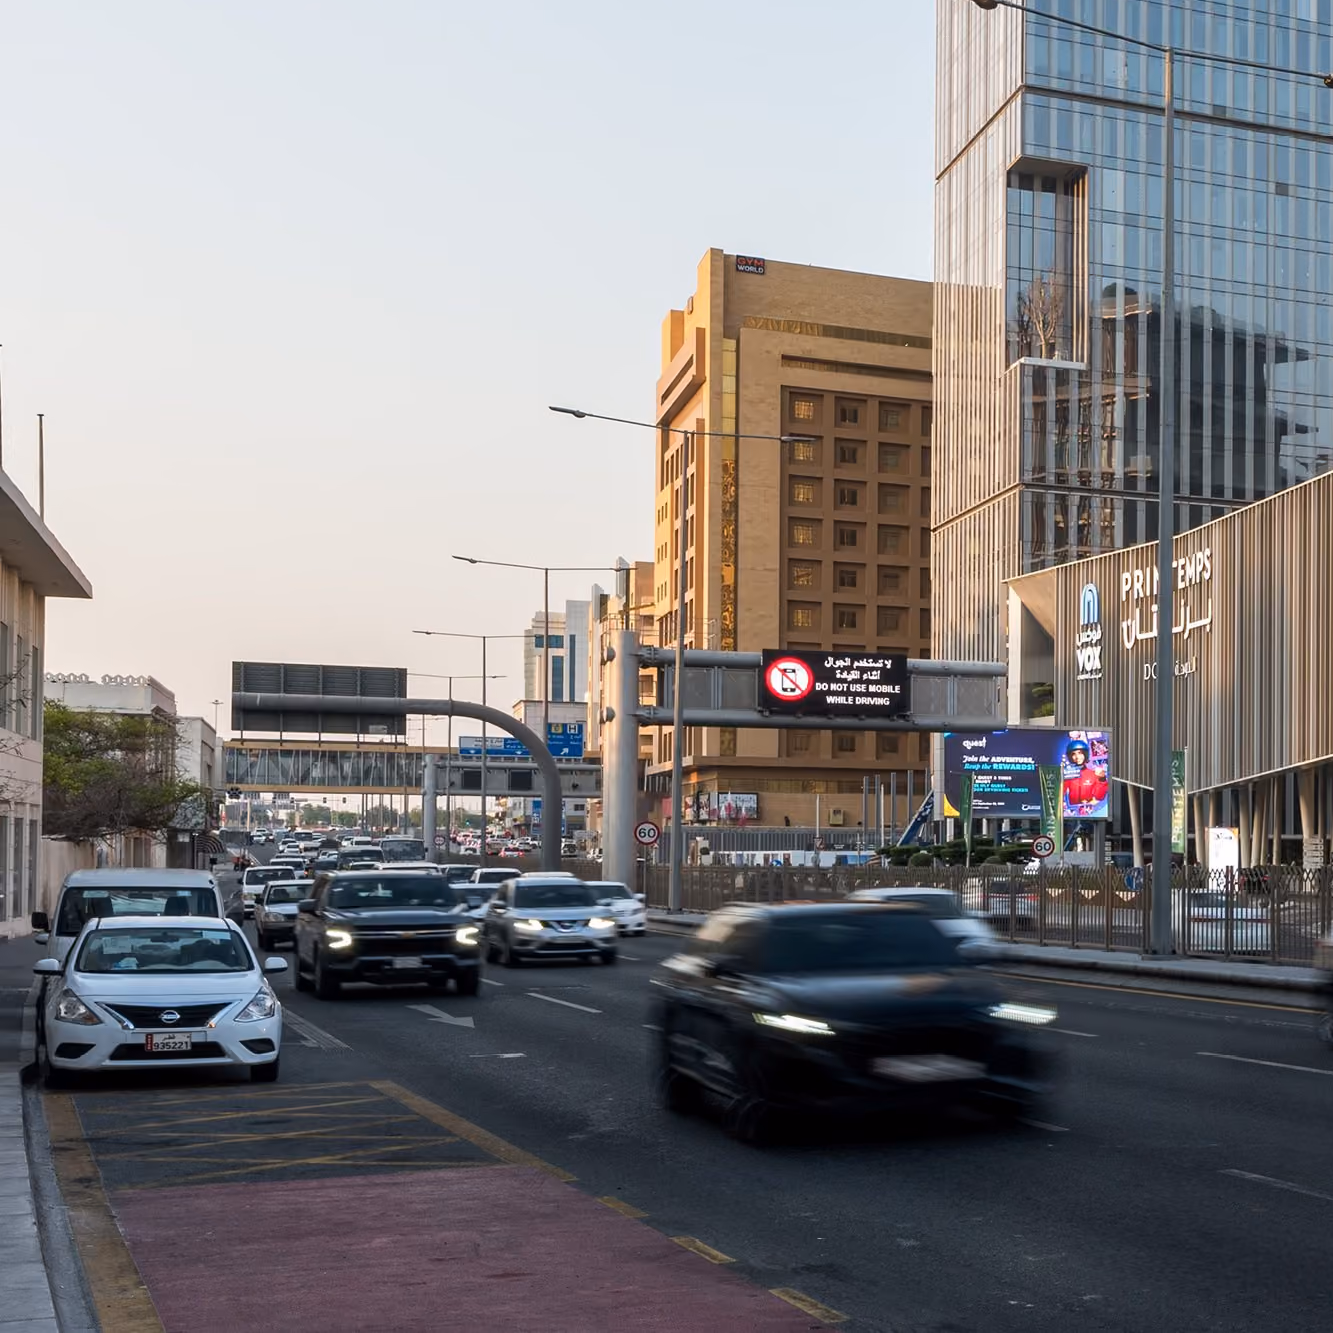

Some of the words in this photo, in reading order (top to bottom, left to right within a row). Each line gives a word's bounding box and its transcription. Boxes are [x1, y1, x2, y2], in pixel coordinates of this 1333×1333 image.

[737, 257, 764, 266] GYM
[737, 265, 764, 274] WORLD
[824, 656, 850, 668] الجوال
[1076, 646, 1102, 671] VOX
[835, 669, 860, 682] القيادة
[815, 683, 828, 691] DO
[830, 683, 847, 692] NOT
[849, 684, 866, 692] USE
[868, 684, 901, 694] MOBILE
[826, 696, 853, 705] WHILE
[855, 696, 890, 706] DRIVING
[962, 736, 986, 750] quest
[962, 755, 978, 763] Join
[638, 828, 656, 839] 60
[1035, 841, 1051, 852] 60
[153, 1041, 189, 1050] 935221
